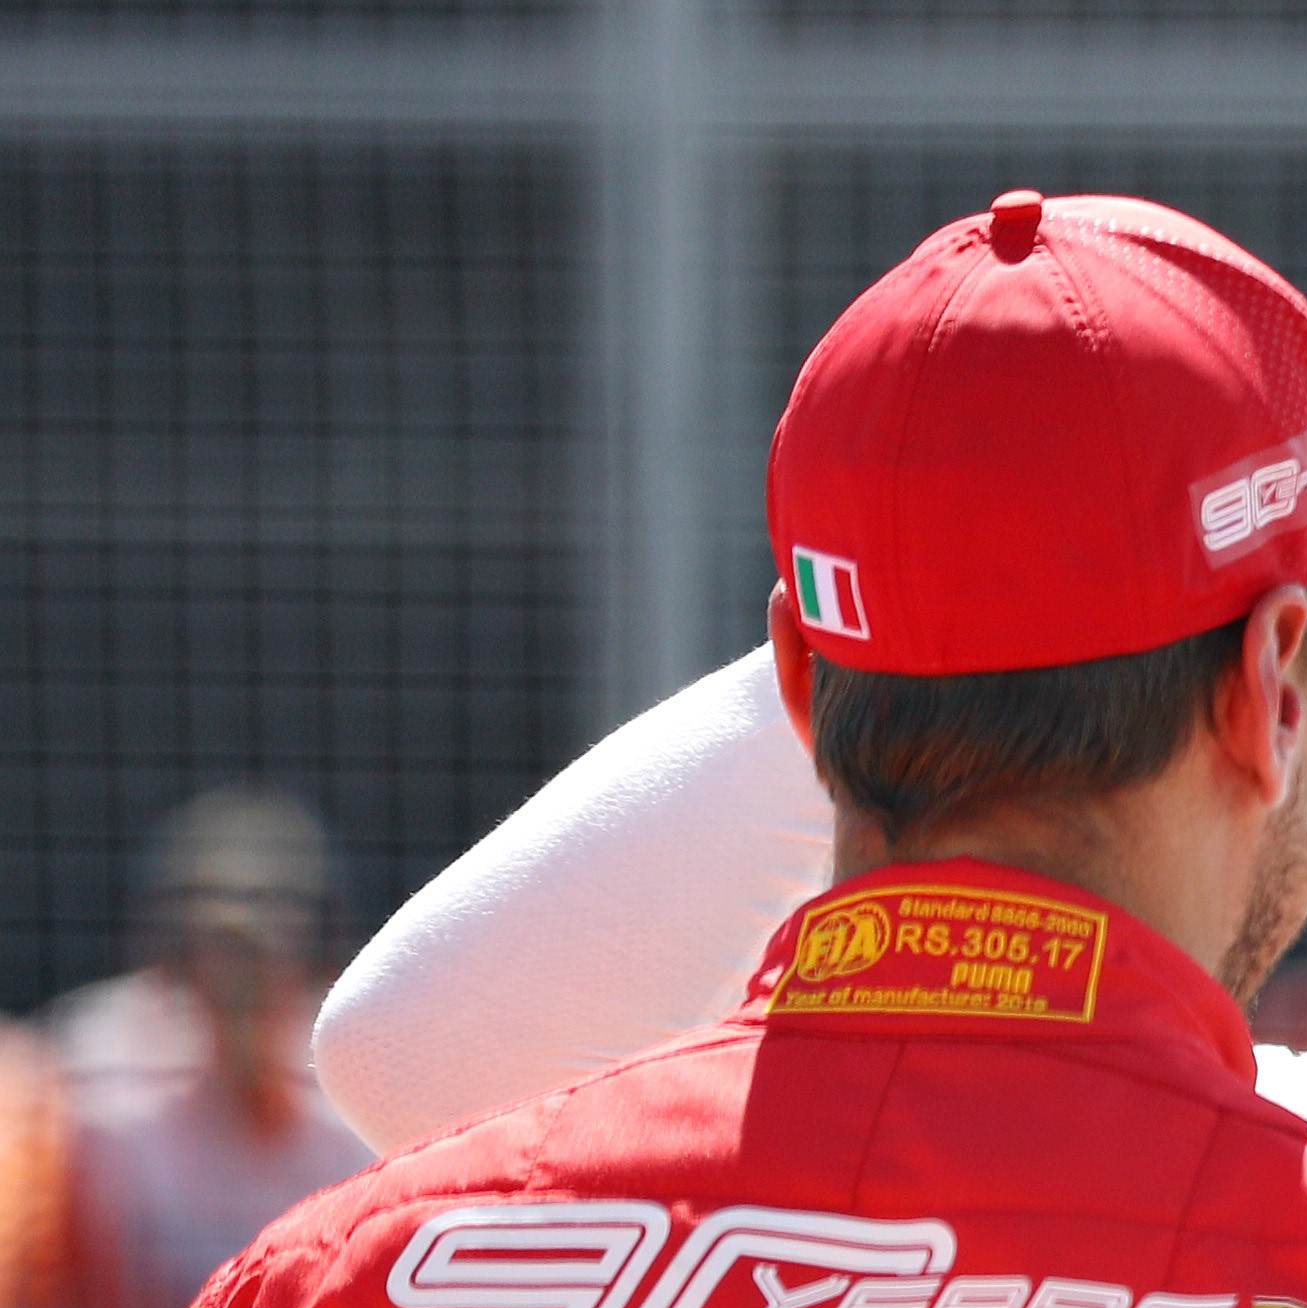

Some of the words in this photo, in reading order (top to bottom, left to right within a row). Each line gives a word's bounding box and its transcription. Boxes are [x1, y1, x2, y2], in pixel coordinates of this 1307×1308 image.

[899, 899, 990, 922] Standard
[802, 917, 877, 970] FIA
[951, 962, 1033, 994] PUMA
[784, 991, 825, 1006] Year
[828, 988, 852, 1004] of
